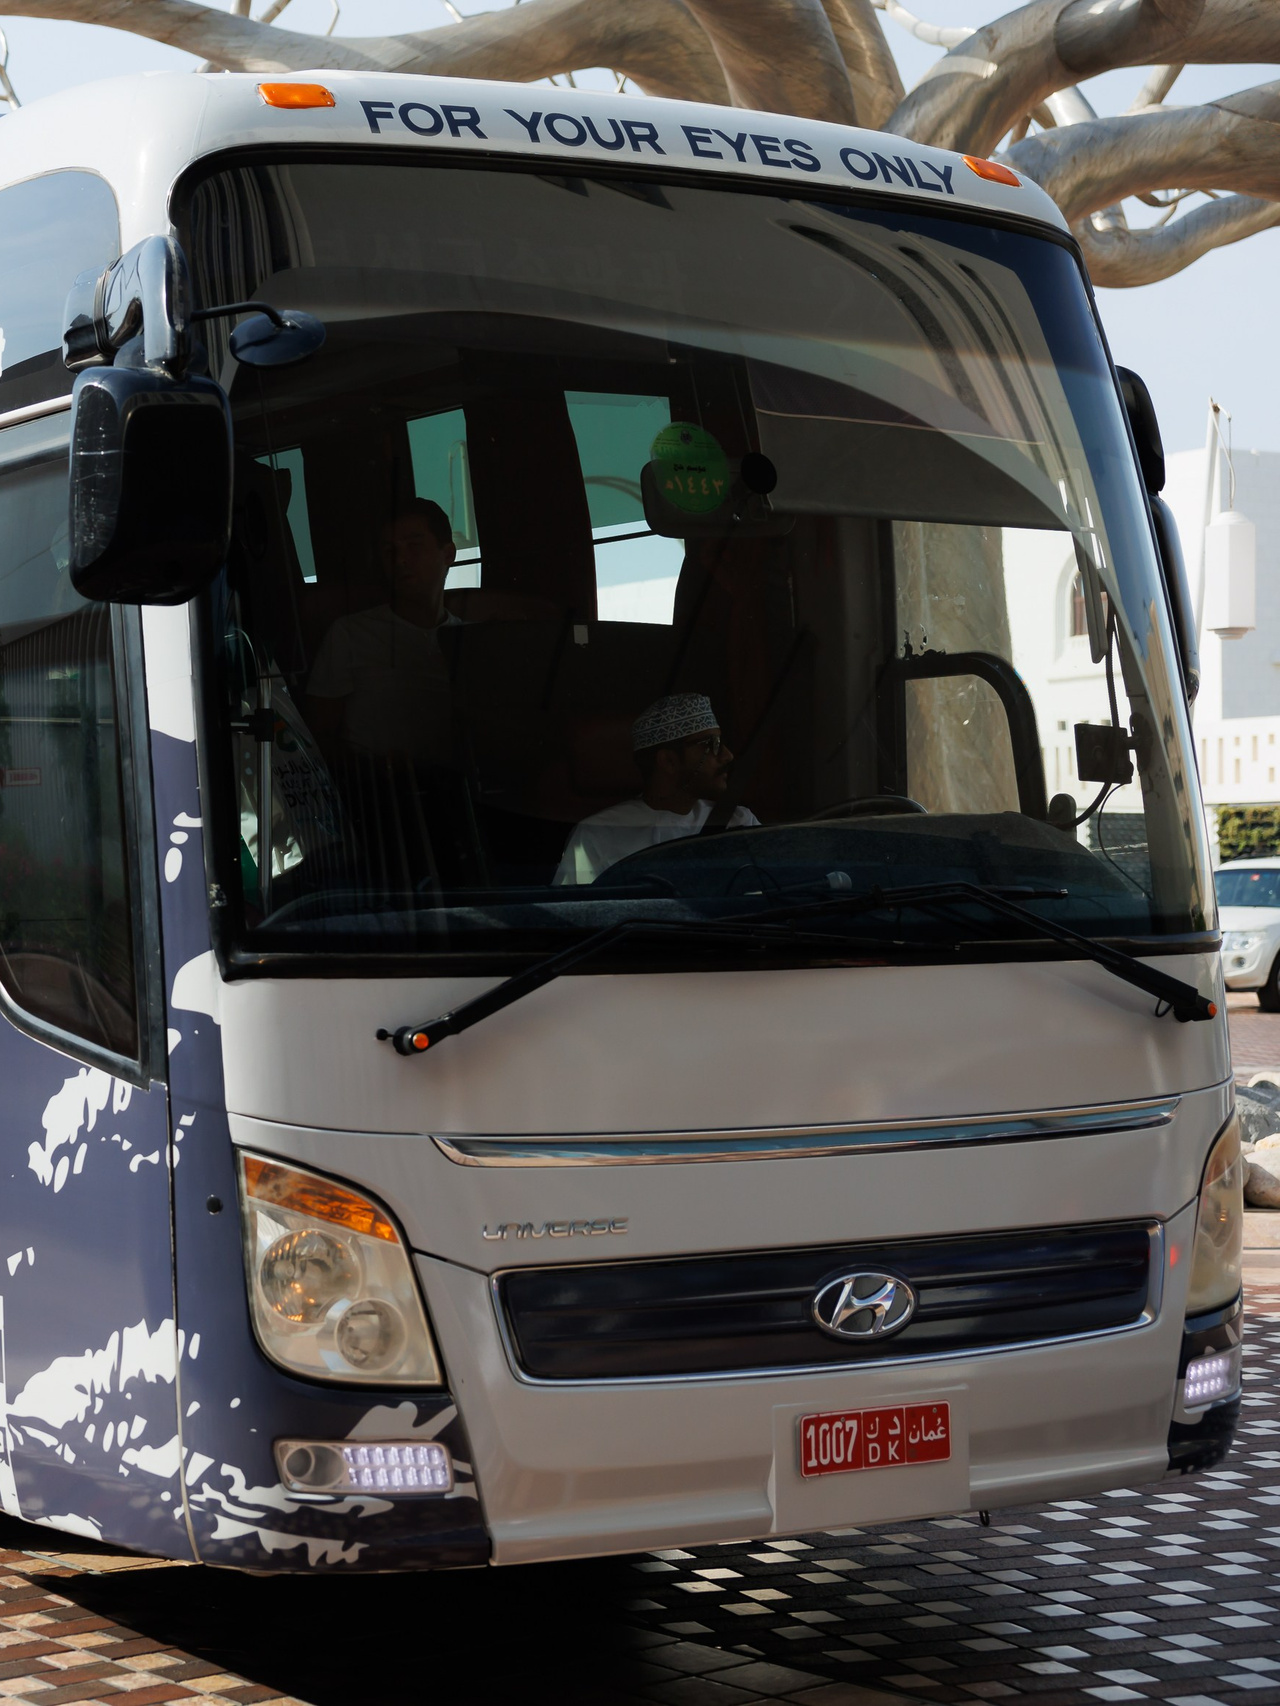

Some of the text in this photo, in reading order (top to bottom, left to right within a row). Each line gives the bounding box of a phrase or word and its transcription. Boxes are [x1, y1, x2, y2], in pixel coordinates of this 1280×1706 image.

[359, 100, 956, 195] FOR YOUR EYES ONLY
[482, 1216, 630, 1241] UNIVERSE
[806, 1419, 858, 1468] 1007
[868, 1440, 900, 1463] D K
